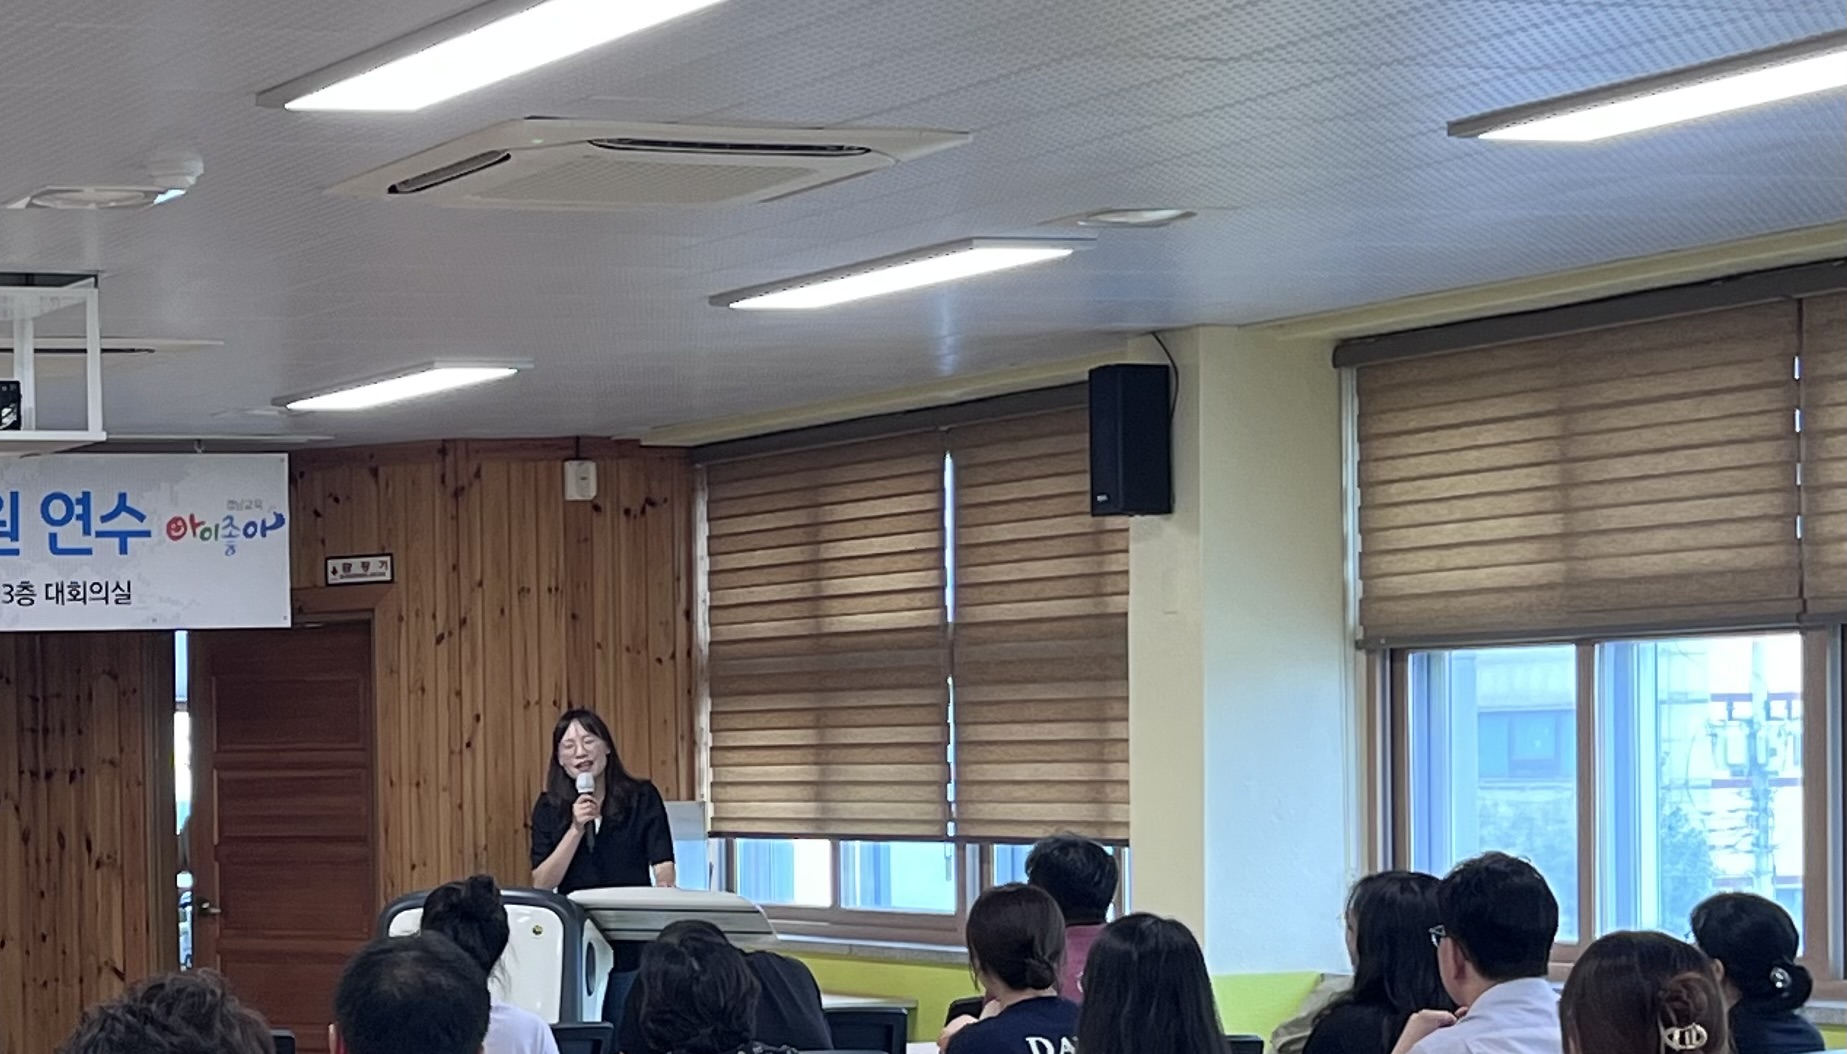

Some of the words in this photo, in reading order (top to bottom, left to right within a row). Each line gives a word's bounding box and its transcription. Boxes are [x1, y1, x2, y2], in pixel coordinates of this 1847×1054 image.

[39, 489, 153, 557] 연수
[1, 580, 38, 607] 3층
[44, 580, 133, 607] 대회의실
